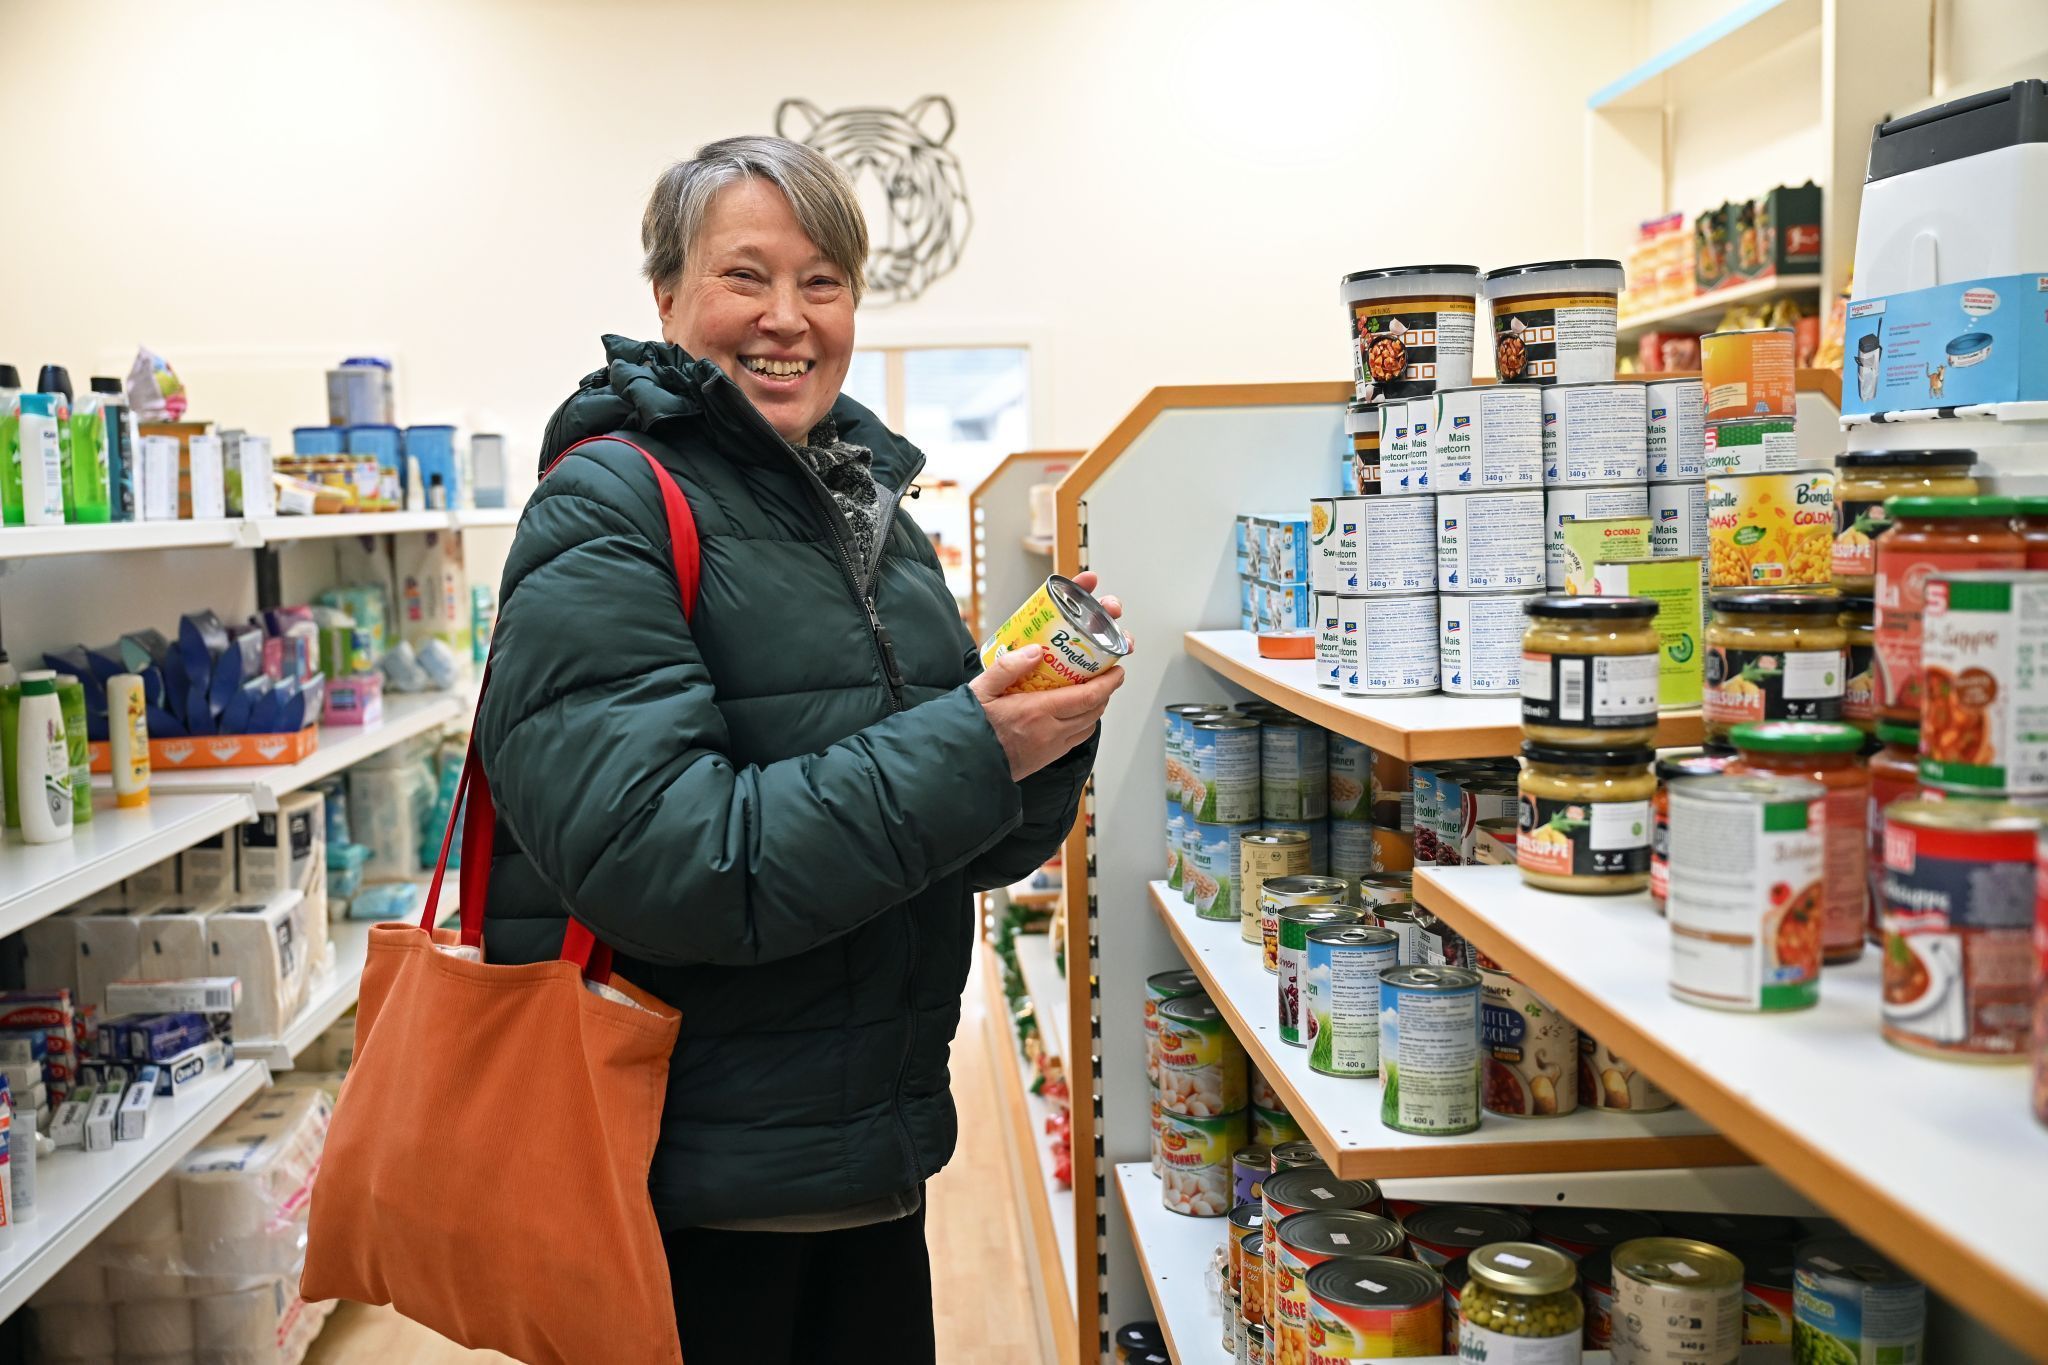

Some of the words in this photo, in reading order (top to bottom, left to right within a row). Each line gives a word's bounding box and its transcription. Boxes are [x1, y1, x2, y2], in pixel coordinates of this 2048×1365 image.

[1448, 433, 1470, 442] Mais
[1680, 465, 1692, 473] 340
[1519, 473, 1528, 481] 285
[1568, 470, 1580, 478] 340
[1612, 528, 1641, 536] CONAD
[1655, 525, 1678, 534] Mais
[1340, 539, 1357, 548] Mais
[1441, 536, 1457, 544] Mais
[1444, 636, 1460, 646] Mais
[1050, 629, 1099, 673] Bonduelle
[1507, 678, 1520, 686] 285
[1413, 1117, 1427, 1125] 400
[1448, 1117, 1461, 1125] 240
